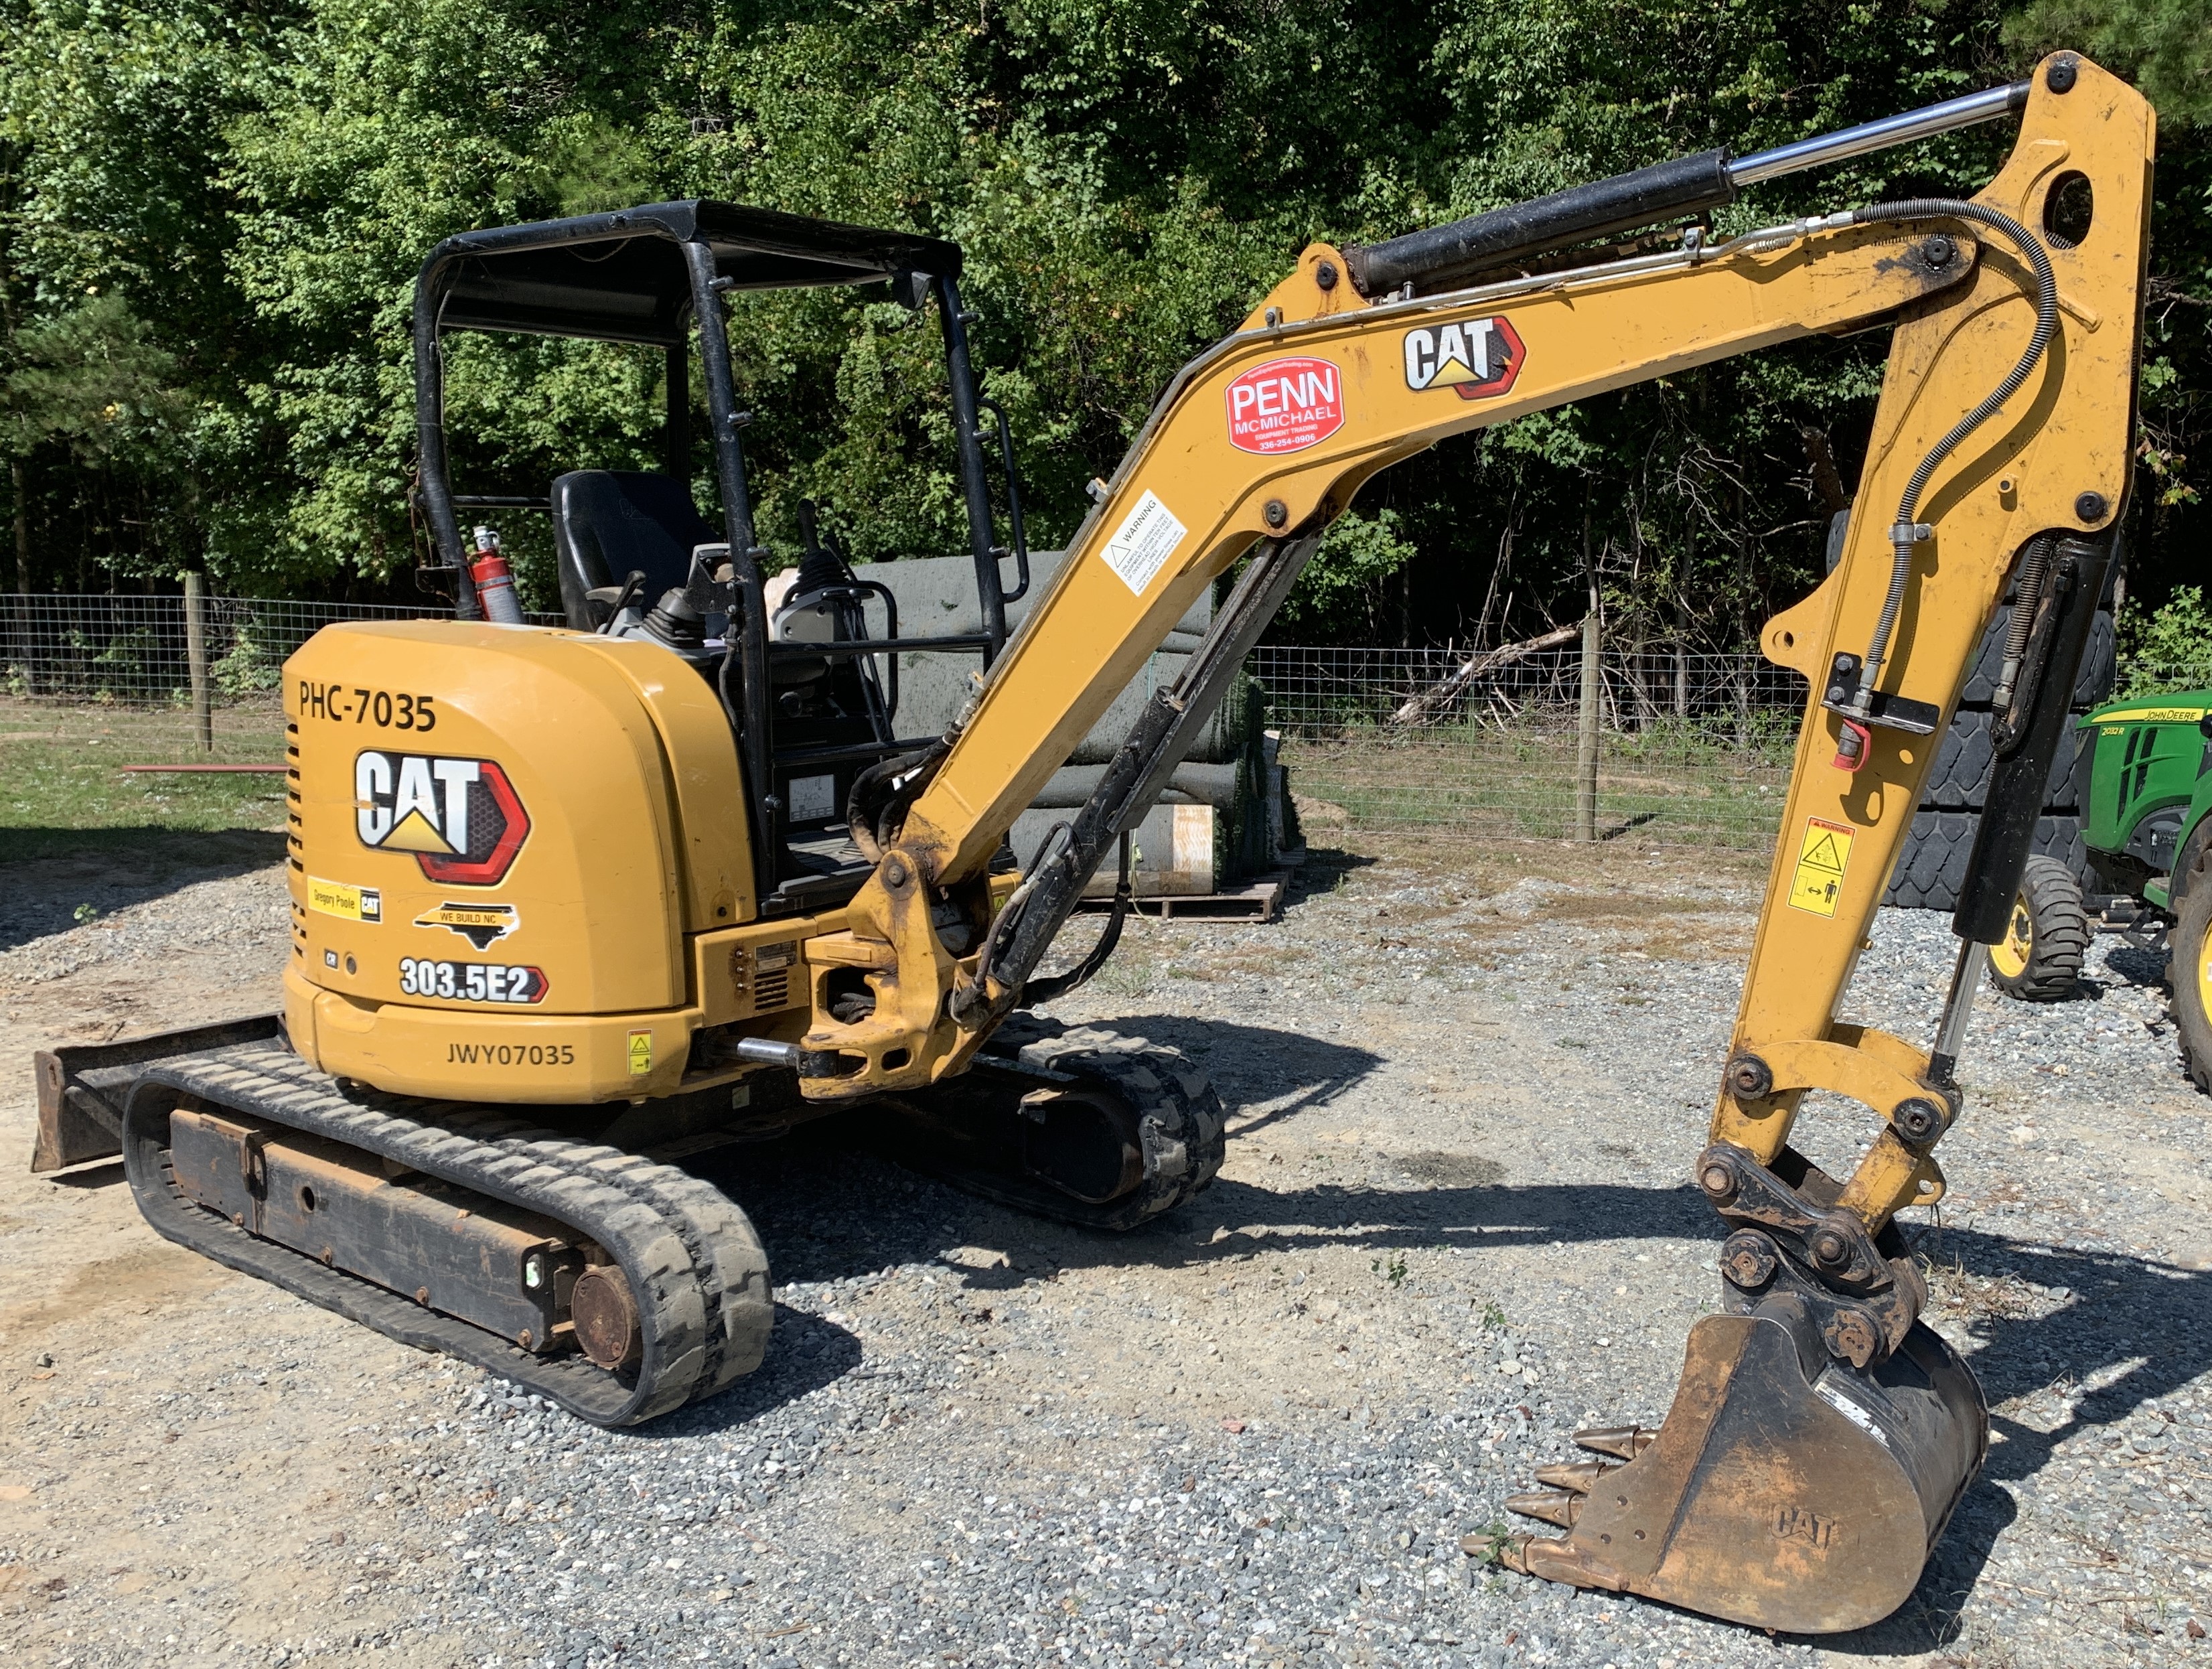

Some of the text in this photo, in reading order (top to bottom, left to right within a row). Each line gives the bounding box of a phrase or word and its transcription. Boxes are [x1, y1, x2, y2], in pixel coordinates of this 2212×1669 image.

[1405, 318, 1493, 389] CAT
[1232, 368, 1335, 421] PENN
[1235, 406, 1337, 435] MCMICHAEL
[1255, 423, 1318, 441] EQUIPMENT TRADING
[1259, 433, 1316, 450] 336-254-0906
[1122, 499, 1157, 542] WARNING
[1120, 550, 1138, 573] UNLAWFUL
[1141, 523, 1159, 544] OPERATE
[1157, 512, 1166, 524] THIS
[1123, 516, 1169, 577] EQUIPMENT WITHIN TEN FEET
[1131, 551, 1151, 575] OVERHEAD
[1149, 520, 1173, 551] HIGH-VOLTAGE
[1135, 570, 1149, 586] Contact
[1147, 561, 1155, 571] with
[1153, 549, 1165, 562] power
[1163, 538, 1173, 549] lines
[1147, 549, 1158, 563] LINES
[1136, 580, 1147, 593] result
[1149, 564, 1159, 576] death
[1161, 544, 1174, 559] serious
[300, 680, 436, 732] PHC-7035
[2144, 710, 2197, 720] JOHN DEERE
[356, 751, 480, 855] CAT
[1821, 822, 1850, 835] WARNING
[314, 889, 355, 910] Gregory Poole
[362, 896, 379, 915] CAT
[440, 912, 496, 924] WE BUILD NC
[400, 958, 529, 1002] 303.5E2
[447, 1043, 575, 1065] JWY07035
[1771, 1504, 1836, 1550] CAT
